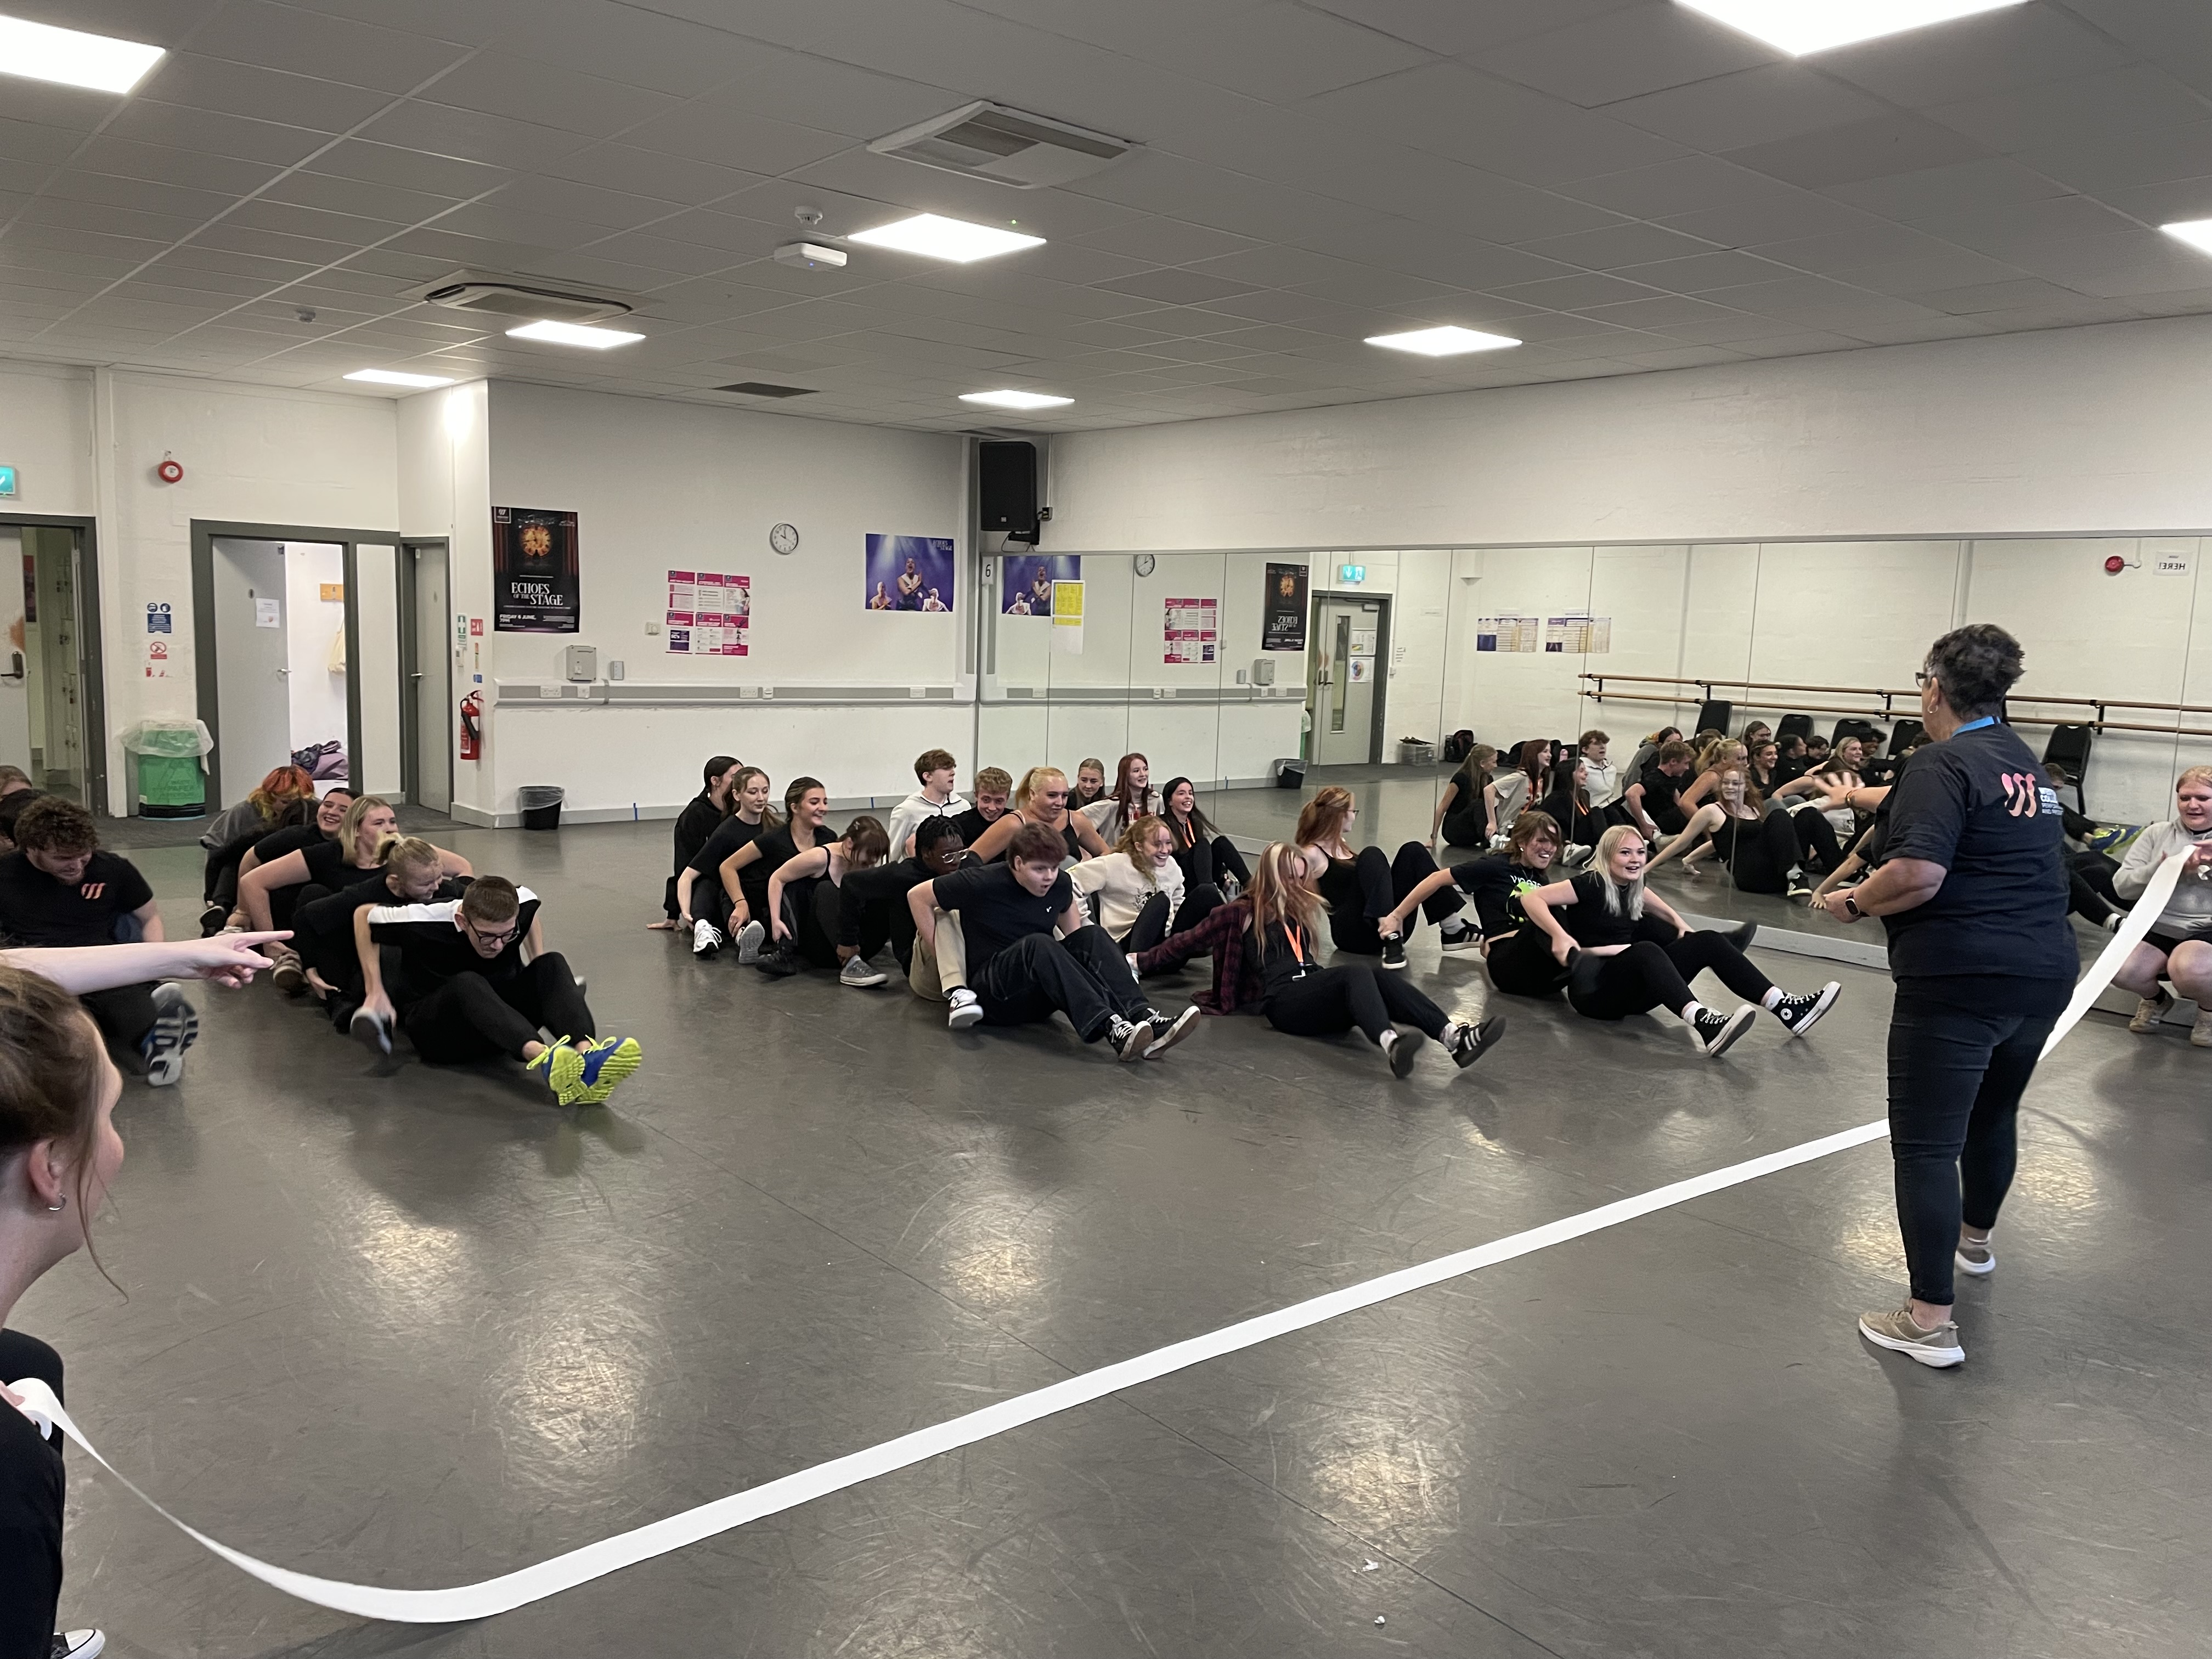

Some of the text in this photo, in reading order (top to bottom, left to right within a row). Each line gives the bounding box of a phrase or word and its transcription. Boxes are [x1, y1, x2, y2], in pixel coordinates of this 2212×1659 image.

[985, 564, 991, 577] 6
[511, 582, 550, 594] ECHOES
[530, 594, 563, 606] STAGE
